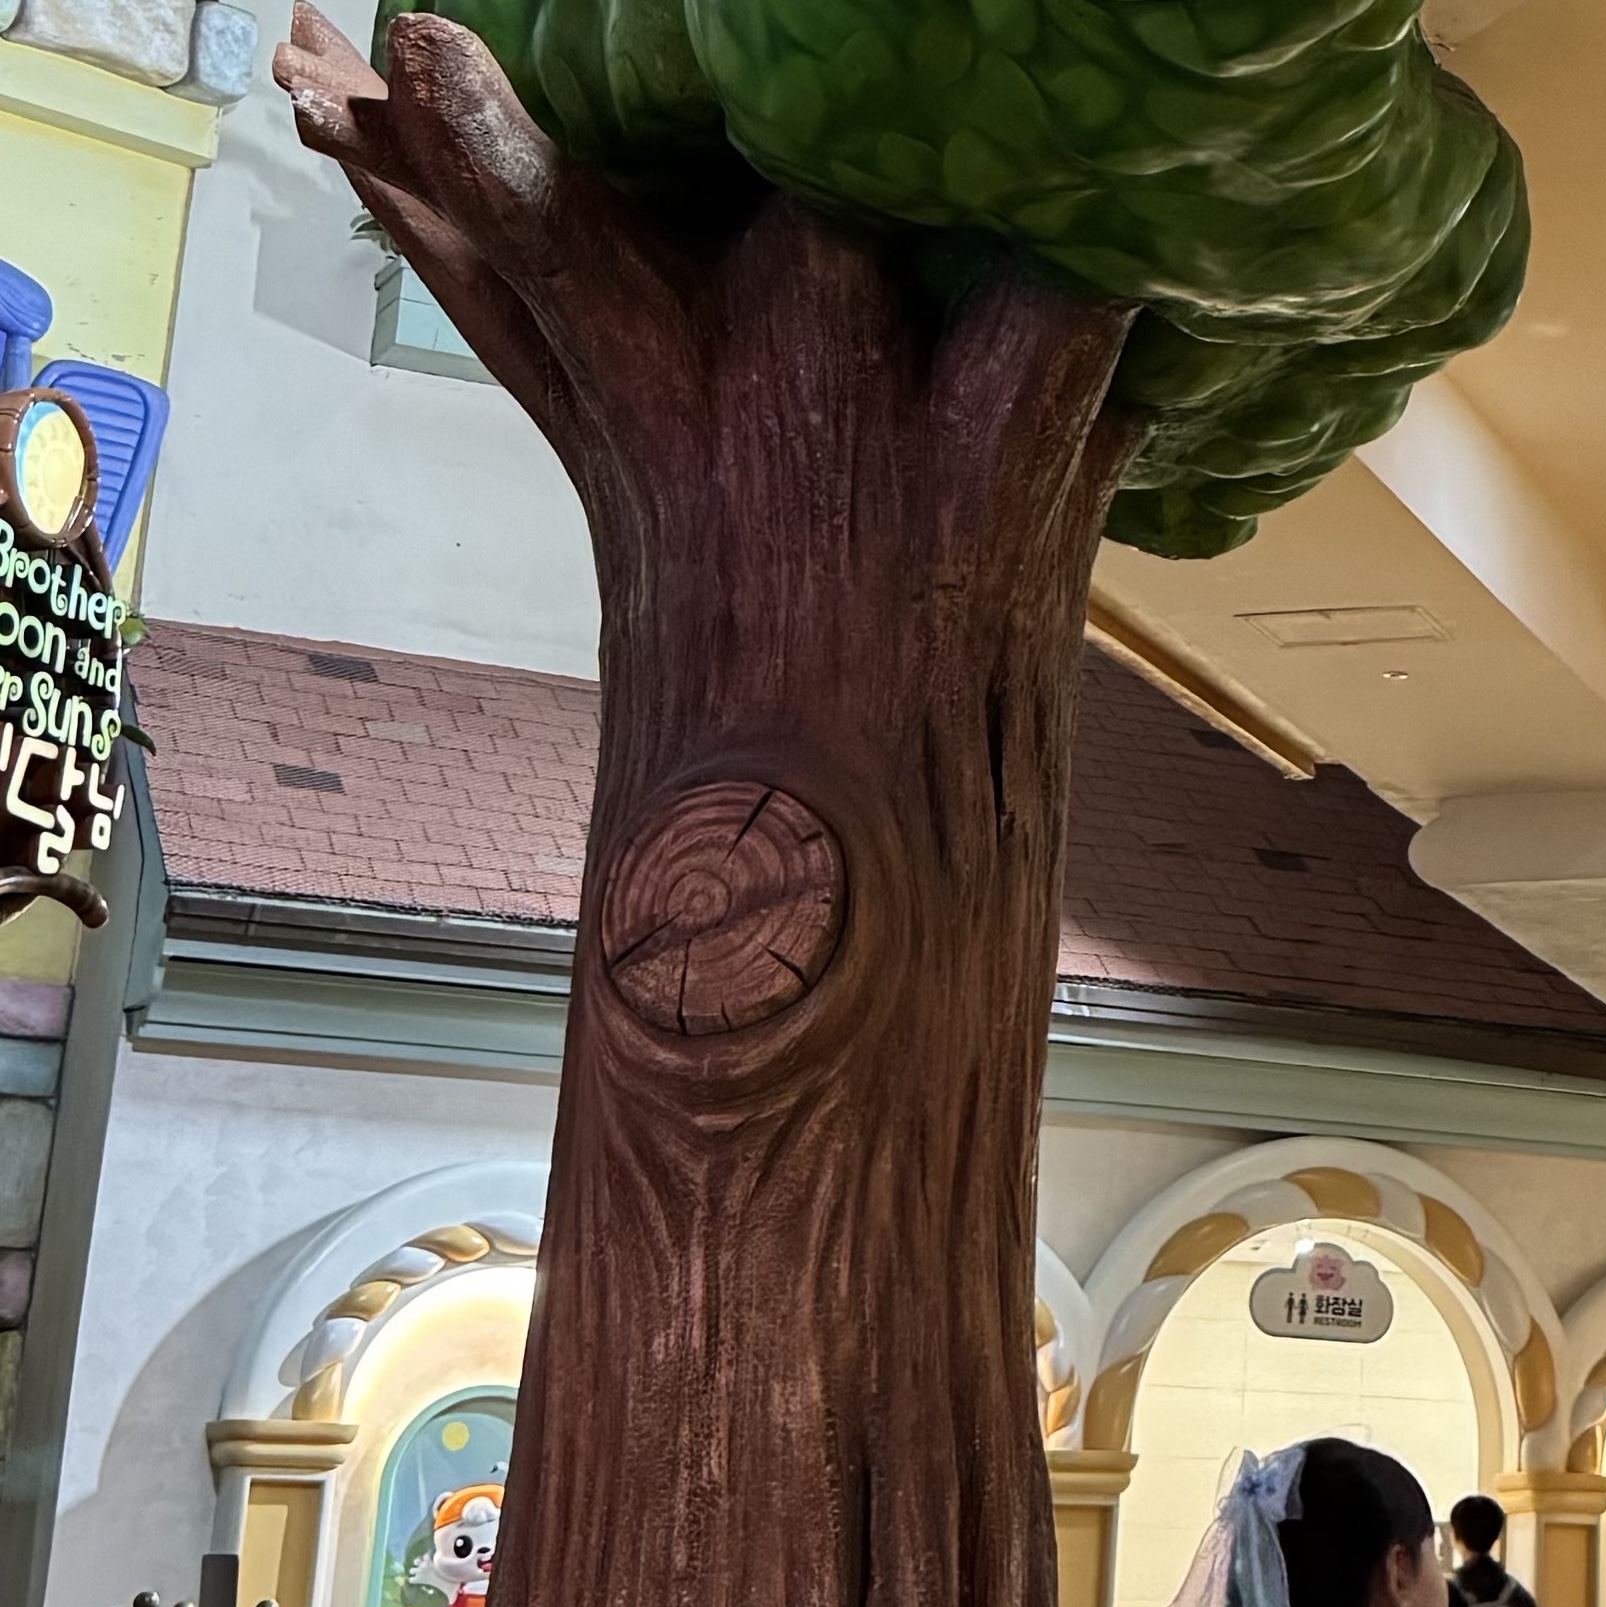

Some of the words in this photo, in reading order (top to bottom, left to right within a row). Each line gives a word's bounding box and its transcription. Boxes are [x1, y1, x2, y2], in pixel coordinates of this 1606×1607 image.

[74, 647, 123, 700] and
[22, 671, 122, 761] Suns
[1315, 1295, 1363, 1318] 화장실
